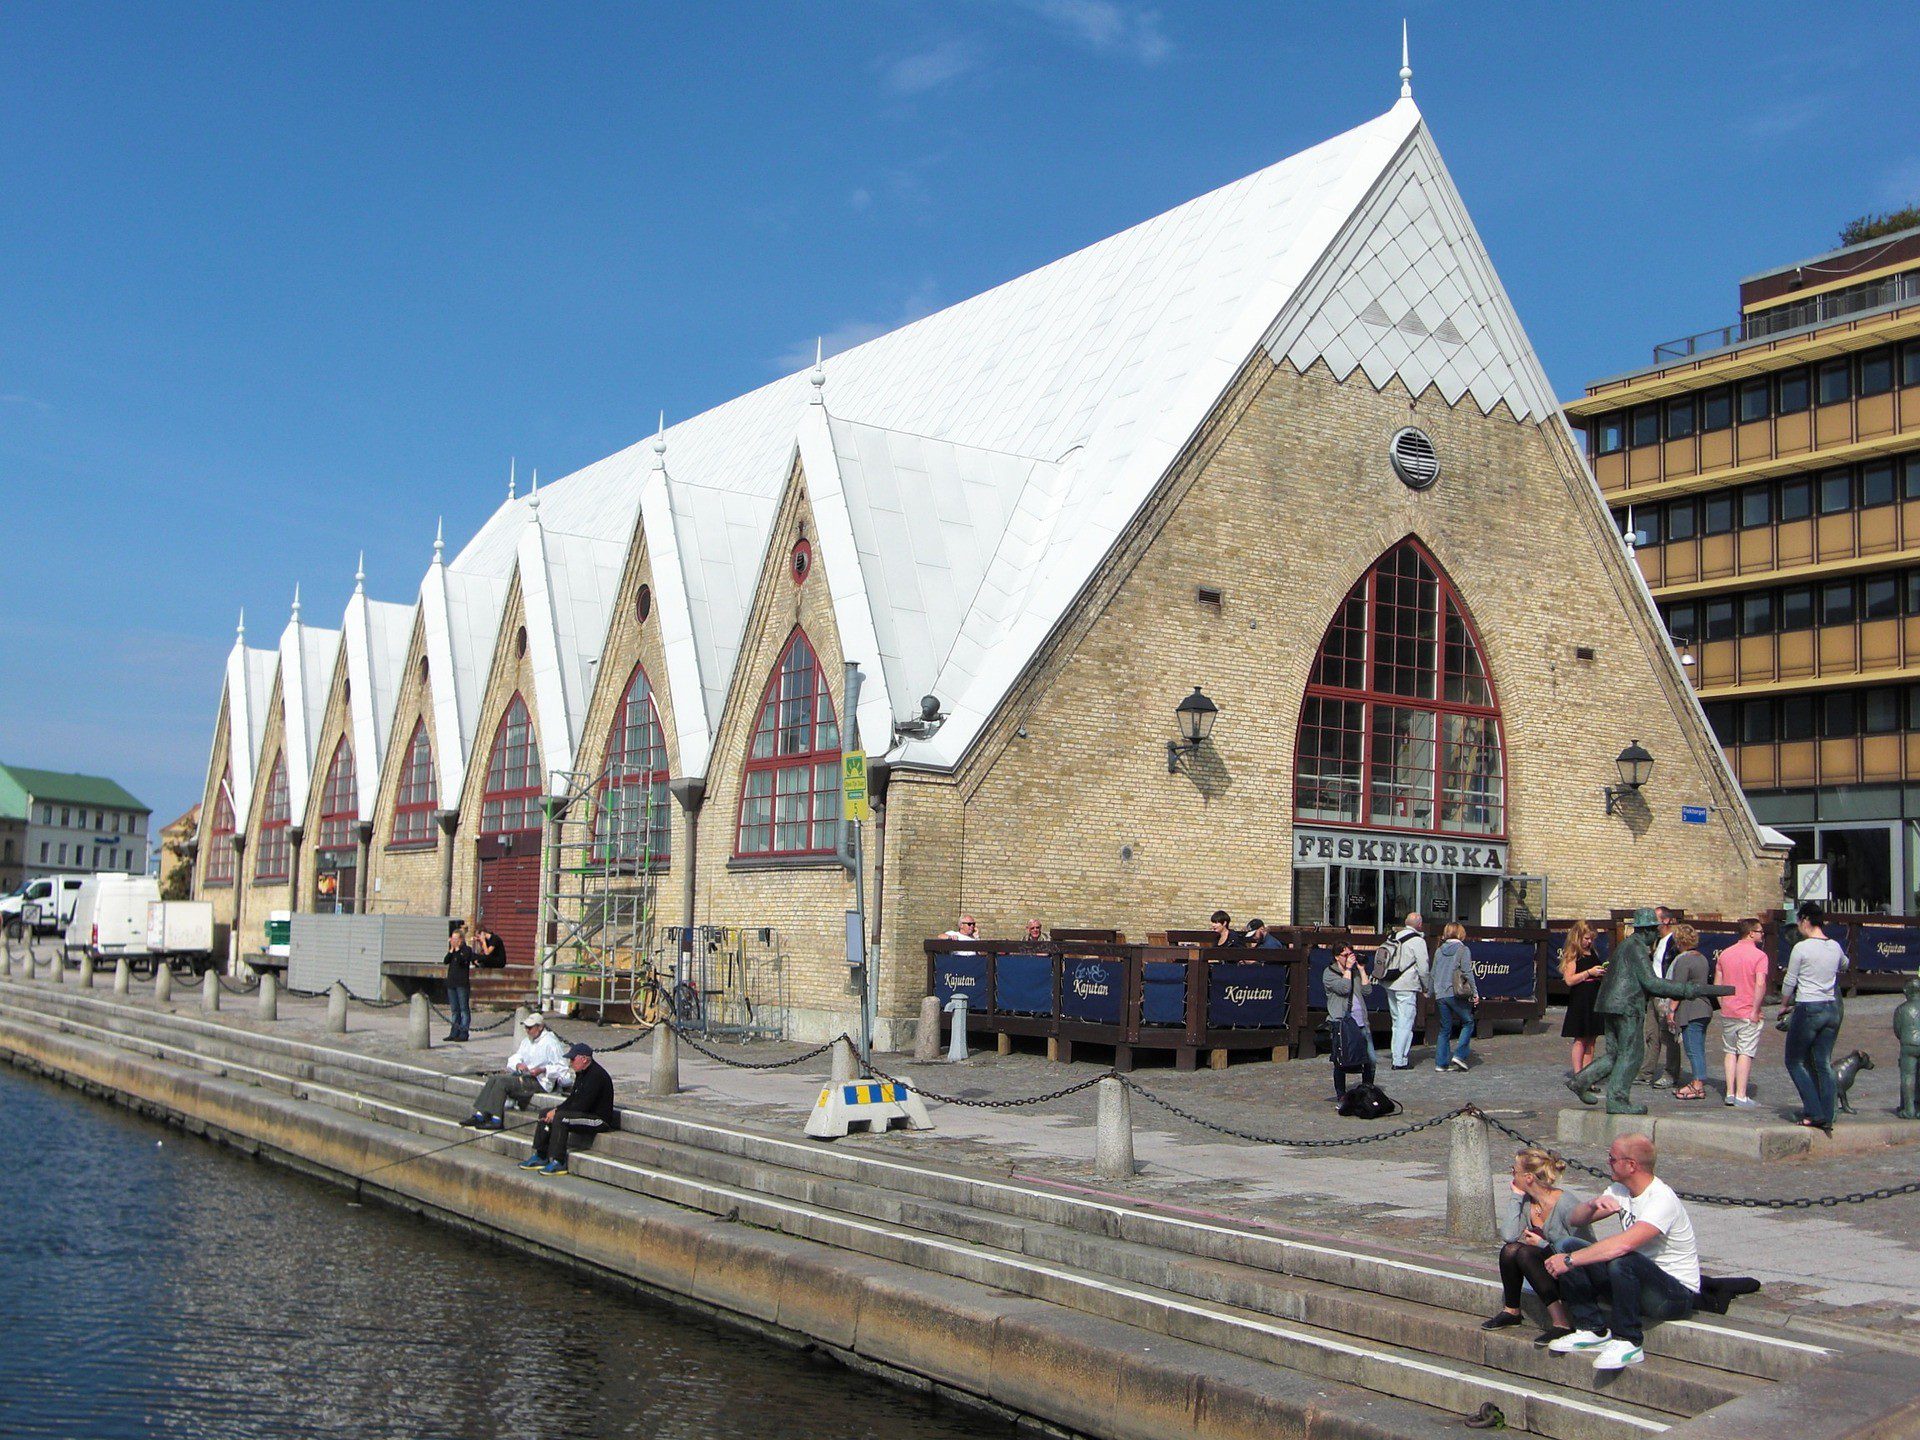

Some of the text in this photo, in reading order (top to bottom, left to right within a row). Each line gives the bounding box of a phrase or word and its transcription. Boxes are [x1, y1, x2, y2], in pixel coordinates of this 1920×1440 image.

[1298, 834, 1502, 870] FESKEKORKA
[1876, 941, 1906, 958] Kajutan
[1470, 960, 1510, 980] Kajutan
[944, 973, 976, 992] Kajutan
[1073, 978, 1109, 1000] Kajutan
[1223, 985, 1273, 1007] Kajutan
